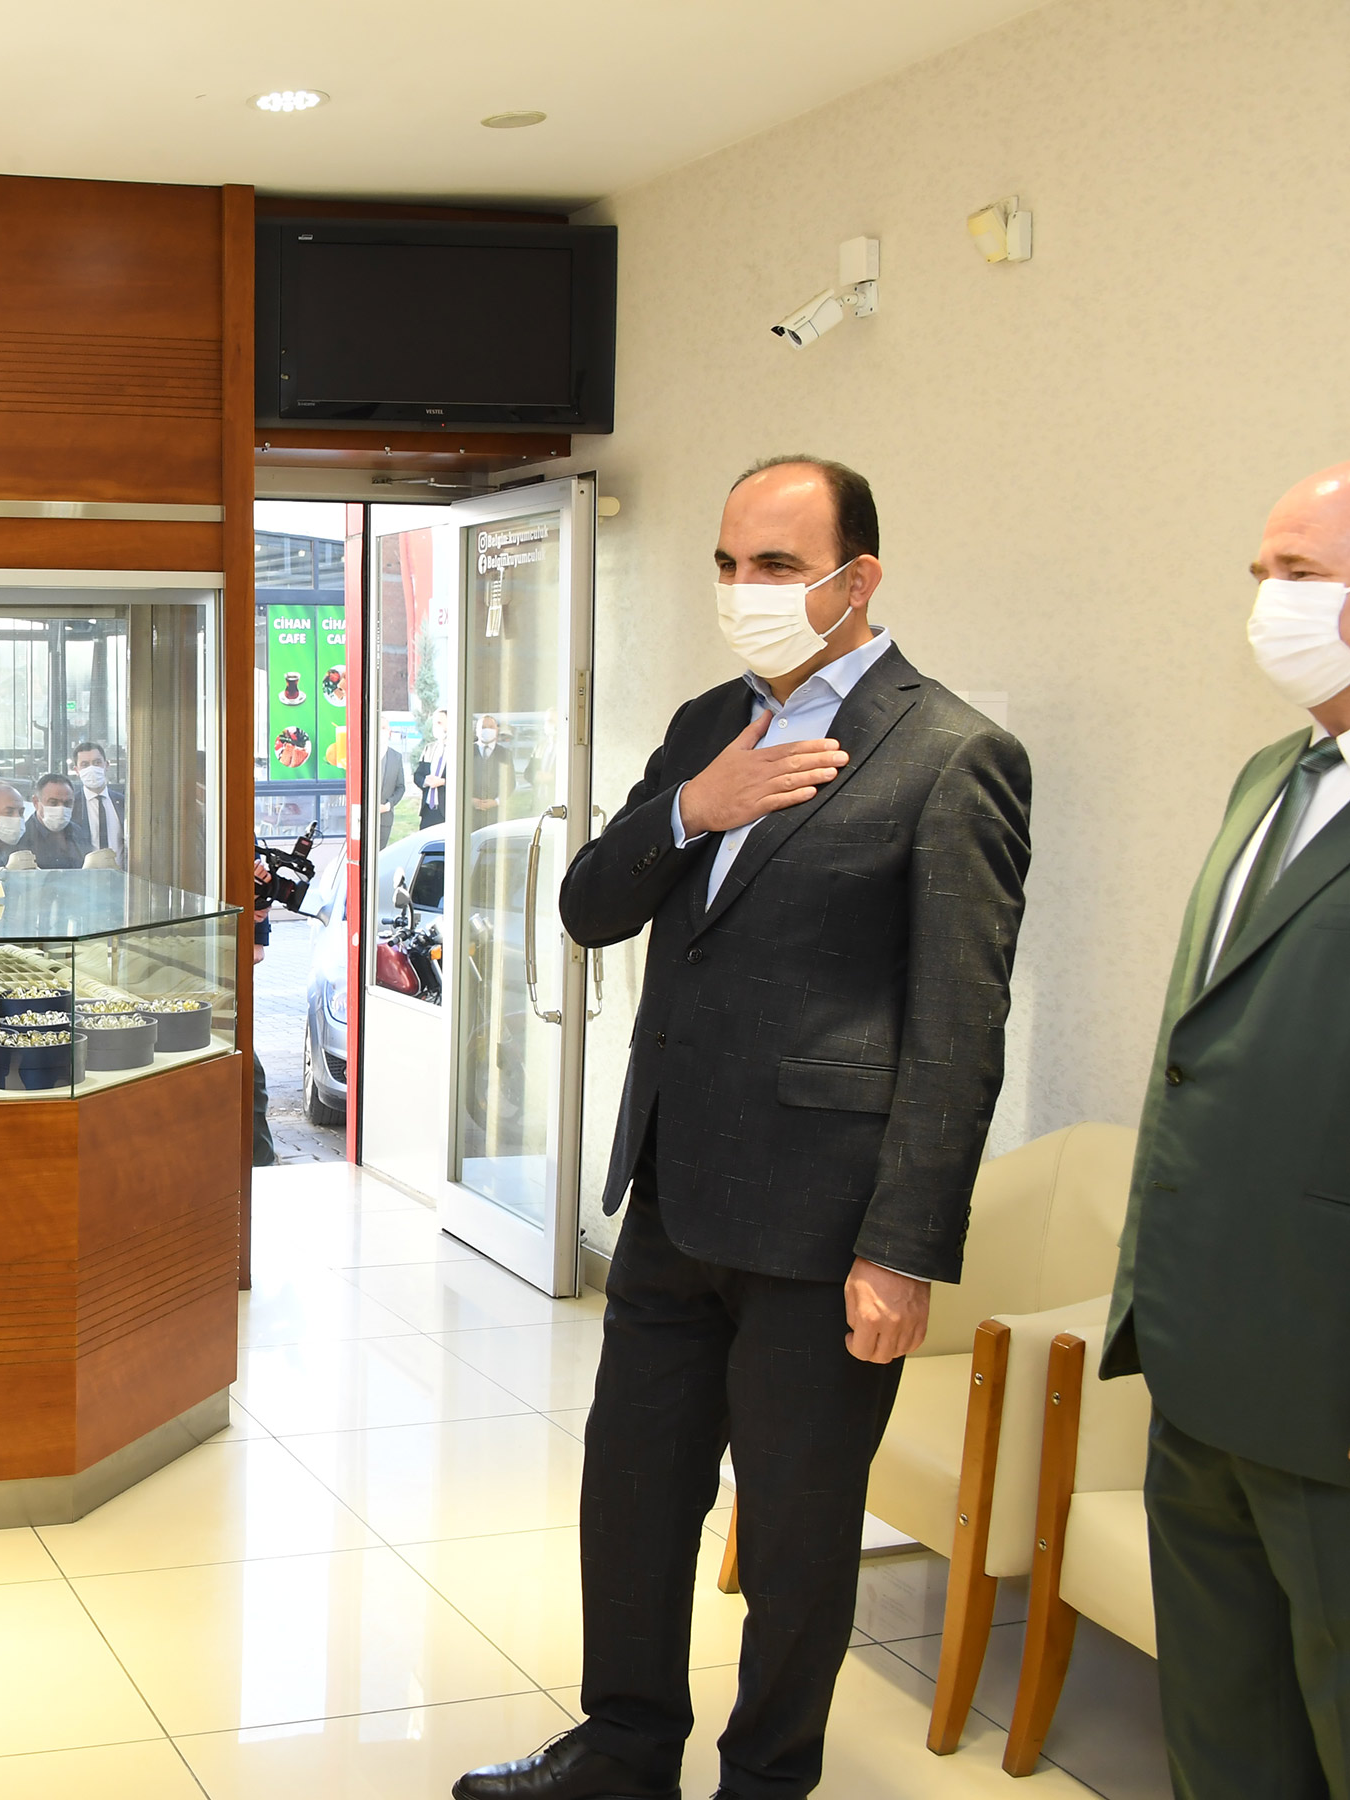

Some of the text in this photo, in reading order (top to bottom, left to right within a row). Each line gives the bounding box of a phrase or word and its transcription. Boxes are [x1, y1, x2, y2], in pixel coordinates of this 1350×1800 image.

[273, 616, 311, 630] CİHAN
[321, 617, 347, 630] CİHA
[278, 633, 307, 645] CAFE
[326, 634, 347, 645] CAF
